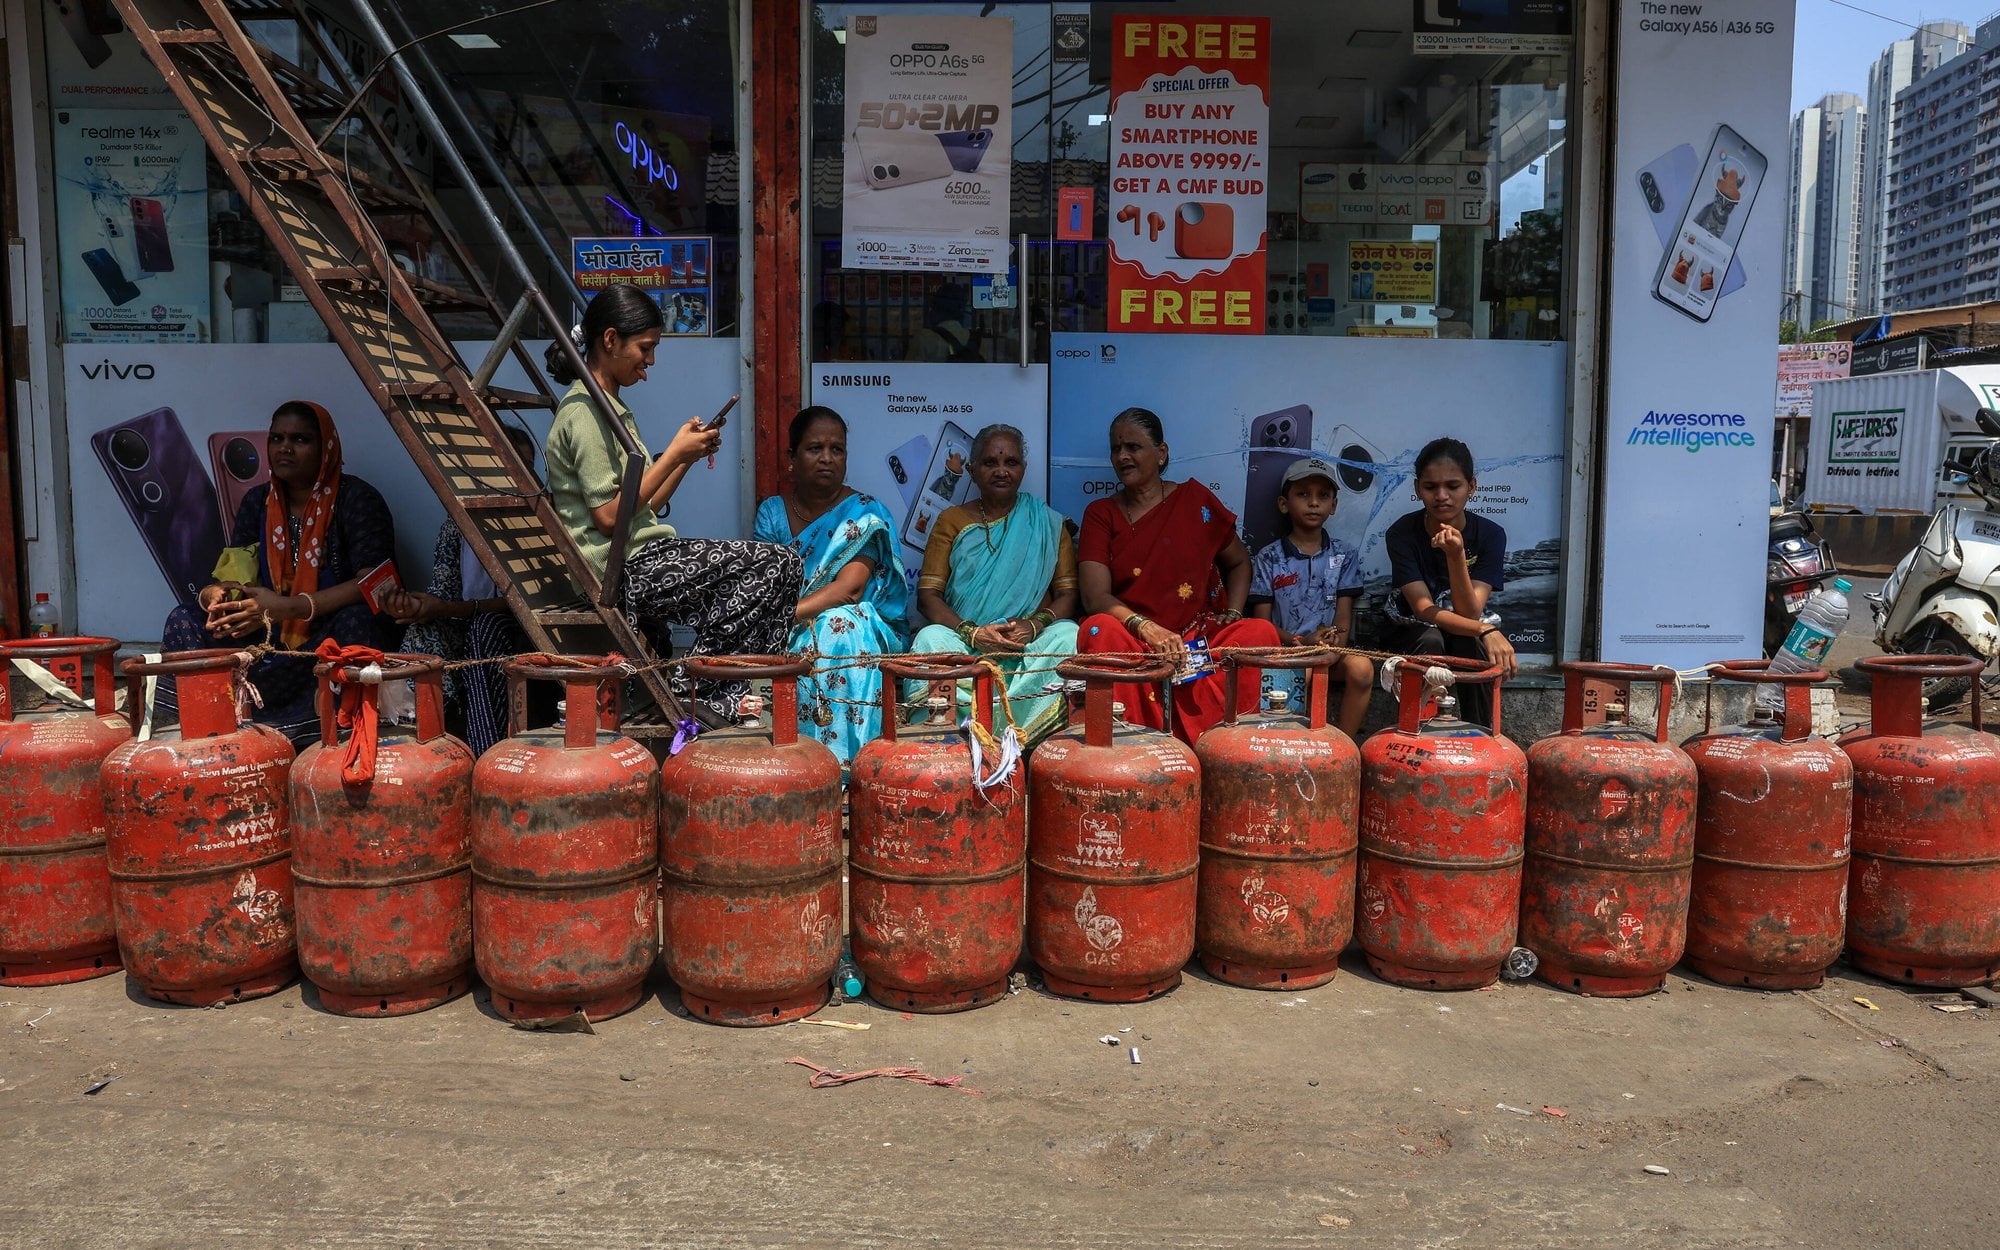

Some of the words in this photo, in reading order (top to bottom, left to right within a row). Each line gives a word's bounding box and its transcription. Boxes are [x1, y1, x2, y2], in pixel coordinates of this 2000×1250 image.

[1640, 2, 1667, 14] The
[1670, 4, 1702, 15] new
[1640, 19, 1691, 36] Galaxy
[1692, 21, 1718, 33] A56
[1726, 21, 1751, 34] A36
[1755, 22, 1775, 34] 5G
[1124, 23, 1256, 60] FREE
[1445, 36, 1475, 44] Instant
[1478, 36, 1513, 44] Discount
[890, 54, 935, 68] OPPO
[939, 54, 969, 69] A6s
[971, 55, 985, 64] 5G
[61, 86, 83, 94] DUAL
[85, 86, 149, 95] PERFORMANCE
[1152, 78, 1195, 93] SPECIAL
[1198, 77, 1230, 90] OFFER
[1145, 103, 1185, 119] BUY
[1191, 104, 1235, 120] ANY
[81, 126, 135, 139] realme
[139, 126, 161, 139] 14x
[1121, 129, 1258, 145] SMARTPHONE
[141, 156, 179, 164] 6000mAh
[614, 121, 680, 191] oppo
[1117, 153, 1184, 169] ABOVE
[1190, 152, 1261, 172] 9999/-
[1113, 178, 1151, 194] GET
[1156, 178, 1171, 193] A
[1177, 178, 1217, 195] CMF
[1223, 179, 1264, 195] BUD
[1379, 174, 1414, 185] vivo
[1419, 177, 1453, 186] oppo
[944, 181, 981, 195] 6500
[909, 244, 917, 253] 3
[948, 245, 971, 256] Zero
[580, 243, 665, 272] मोबाईल
[1120, 289, 1252, 325] FREE
[1056, 349, 1090, 360] oppo
[80, 359, 155, 380] vivo
[822, 375, 891, 387] SAMSUNG
[888, 394, 904, 403] The
[887, 405, 920, 415] Galaxy
[921, 405, 937, 413] A56
[942, 405, 959, 413] A36
[961, 405, 973, 413] 5G
[1641, 410, 1746, 427] Awesome
[1627, 427, 1755, 453] Intelligence
[1209, 482, 1221, 490] 5G
[1482, 496, 1509, 504] Armour
[1510, 496, 1529, 504] Body
[1508, 633, 1545, 643] ColorOS
[1584, 690, 1598, 714] 15.9
[1386, 743, 1415, 753] NETT
[703, 762, 744, 774] DOMESTIC
[1807, 763, 1830, 773] 1906
[237, 836, 249, 845] the
